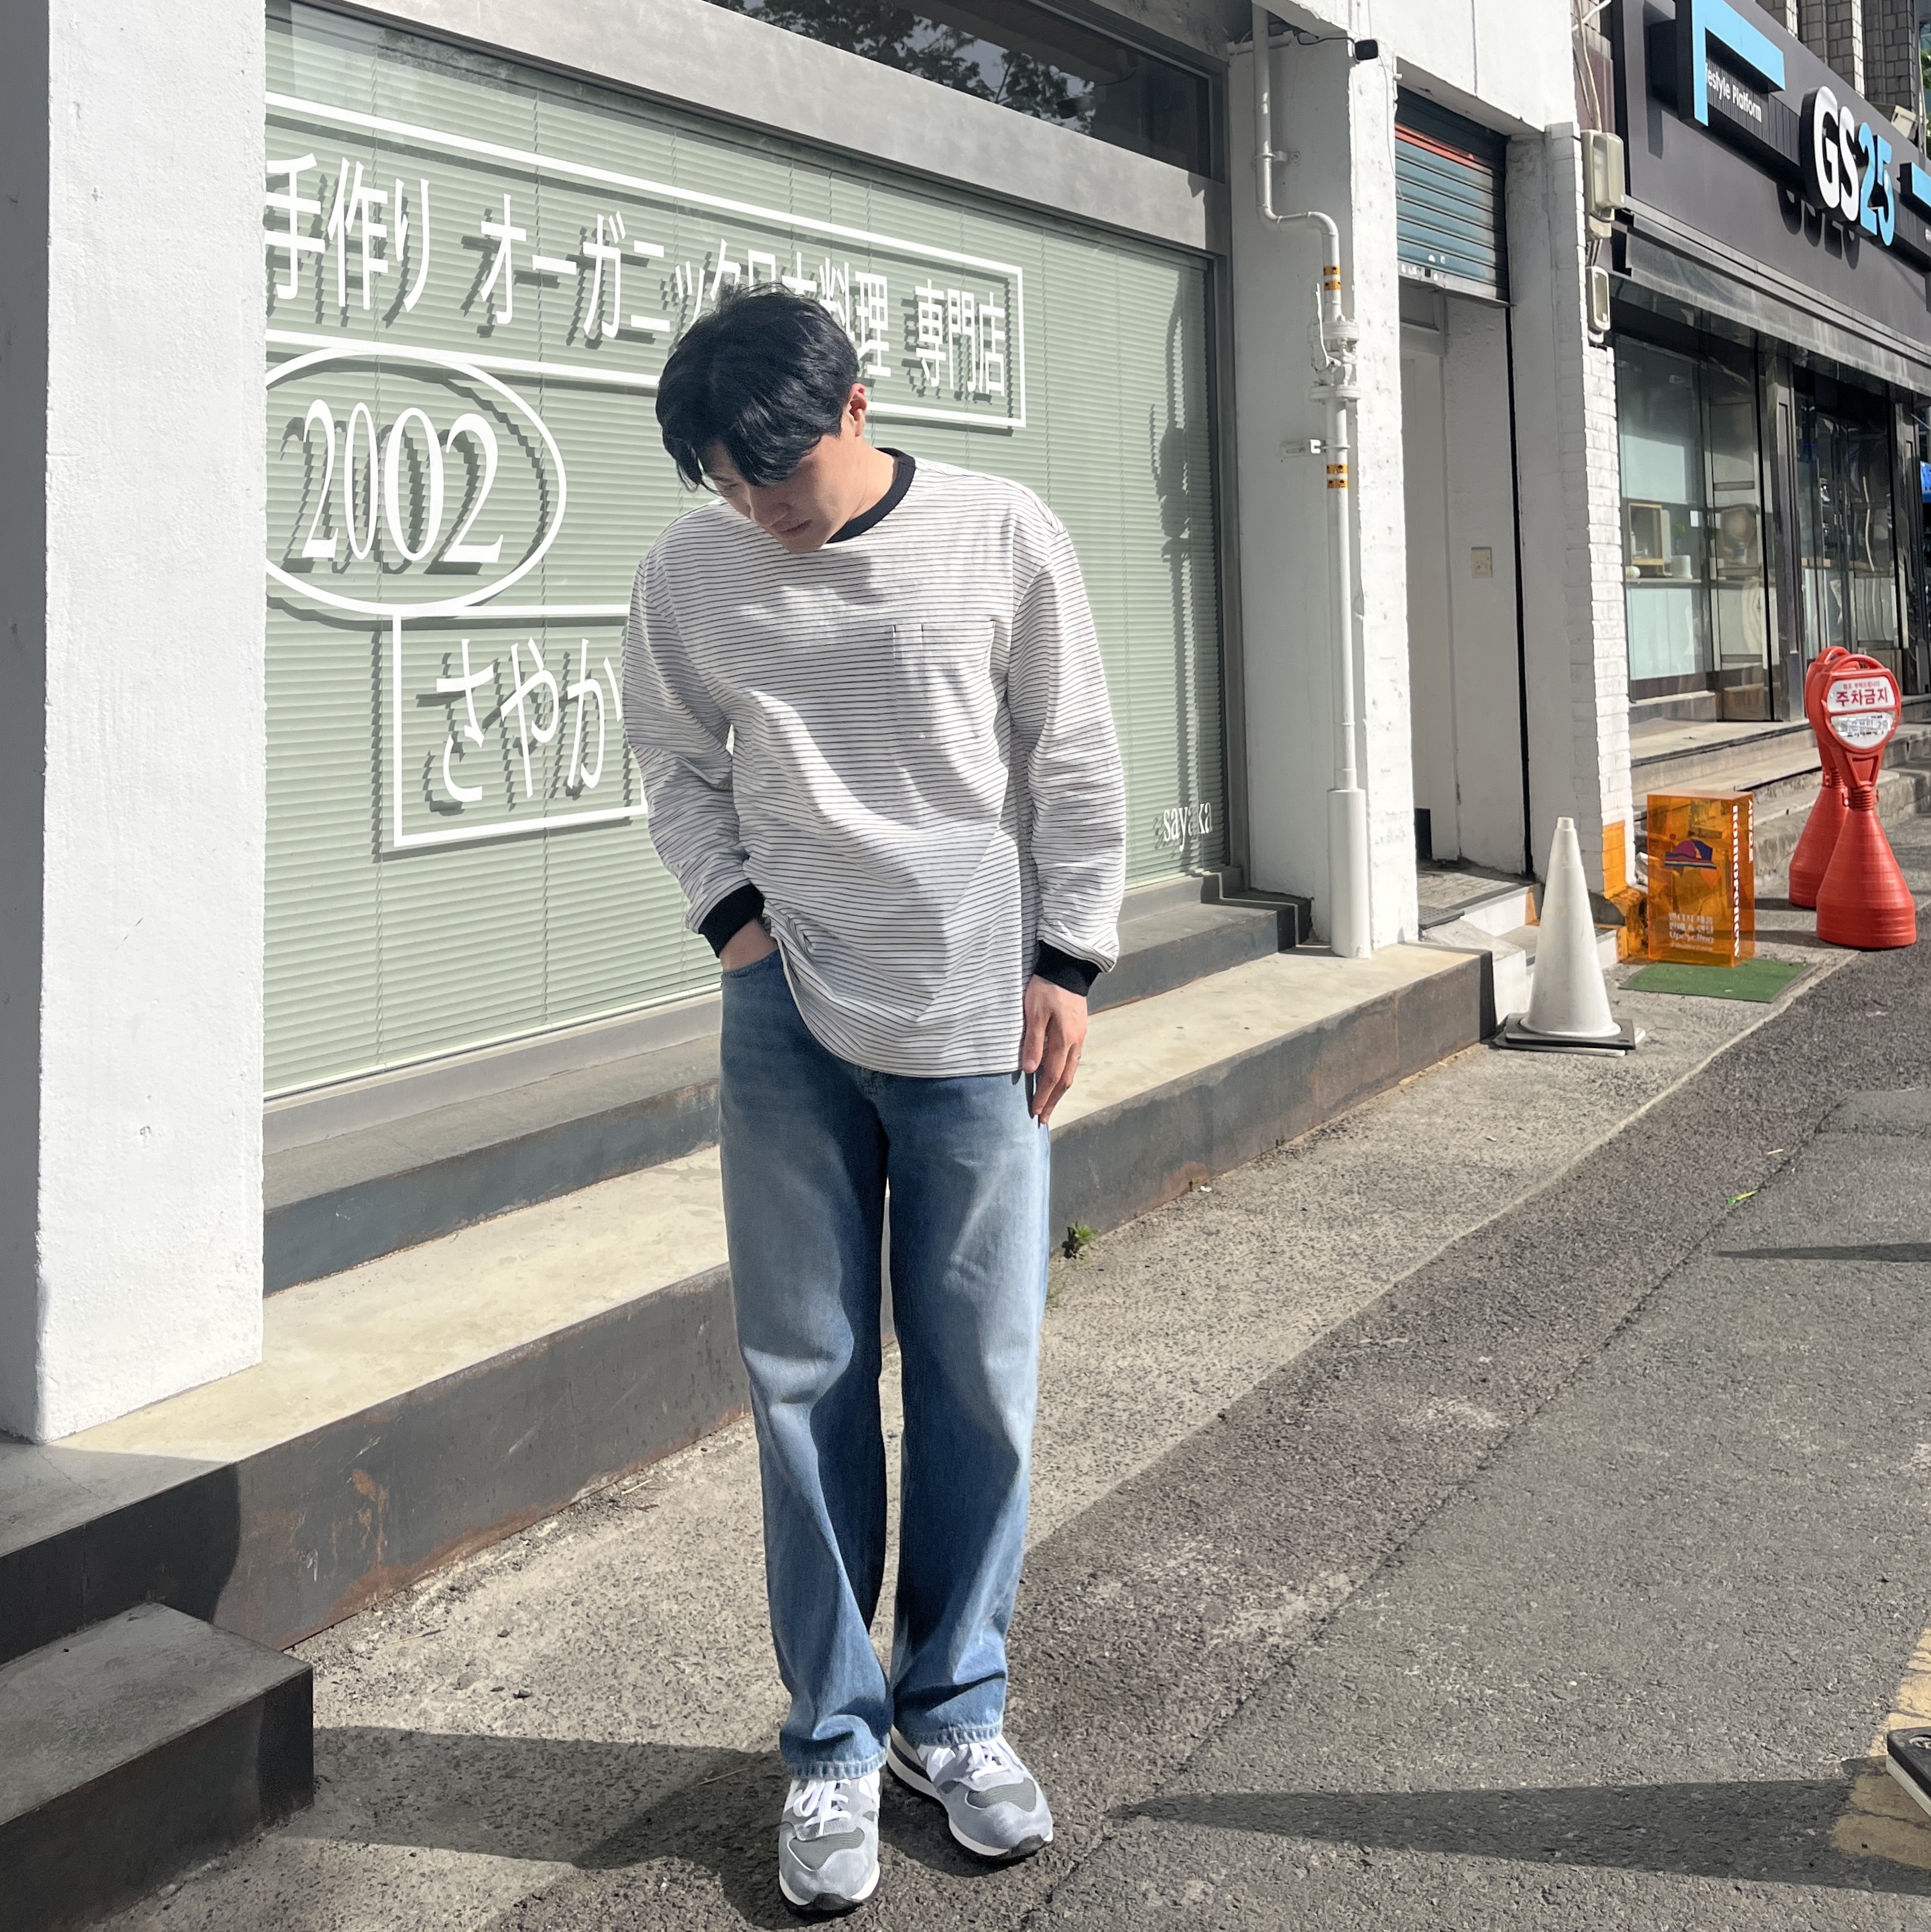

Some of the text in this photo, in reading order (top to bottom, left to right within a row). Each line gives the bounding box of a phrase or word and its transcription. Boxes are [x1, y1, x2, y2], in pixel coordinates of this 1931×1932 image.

[1732, 84, 1762, 123] Platform
[1814, 86, 1895, 246] GS25
[264, 153, 430, 312] 手作り
[915, 279, 1005, 395] 専門店
[302, 399, 503, 563] 2002
[436, 637, 623, 802] さやか
[1836, 687, 1887, 707] 주차금지
[1163, 789, 1212, 852] sayaka
